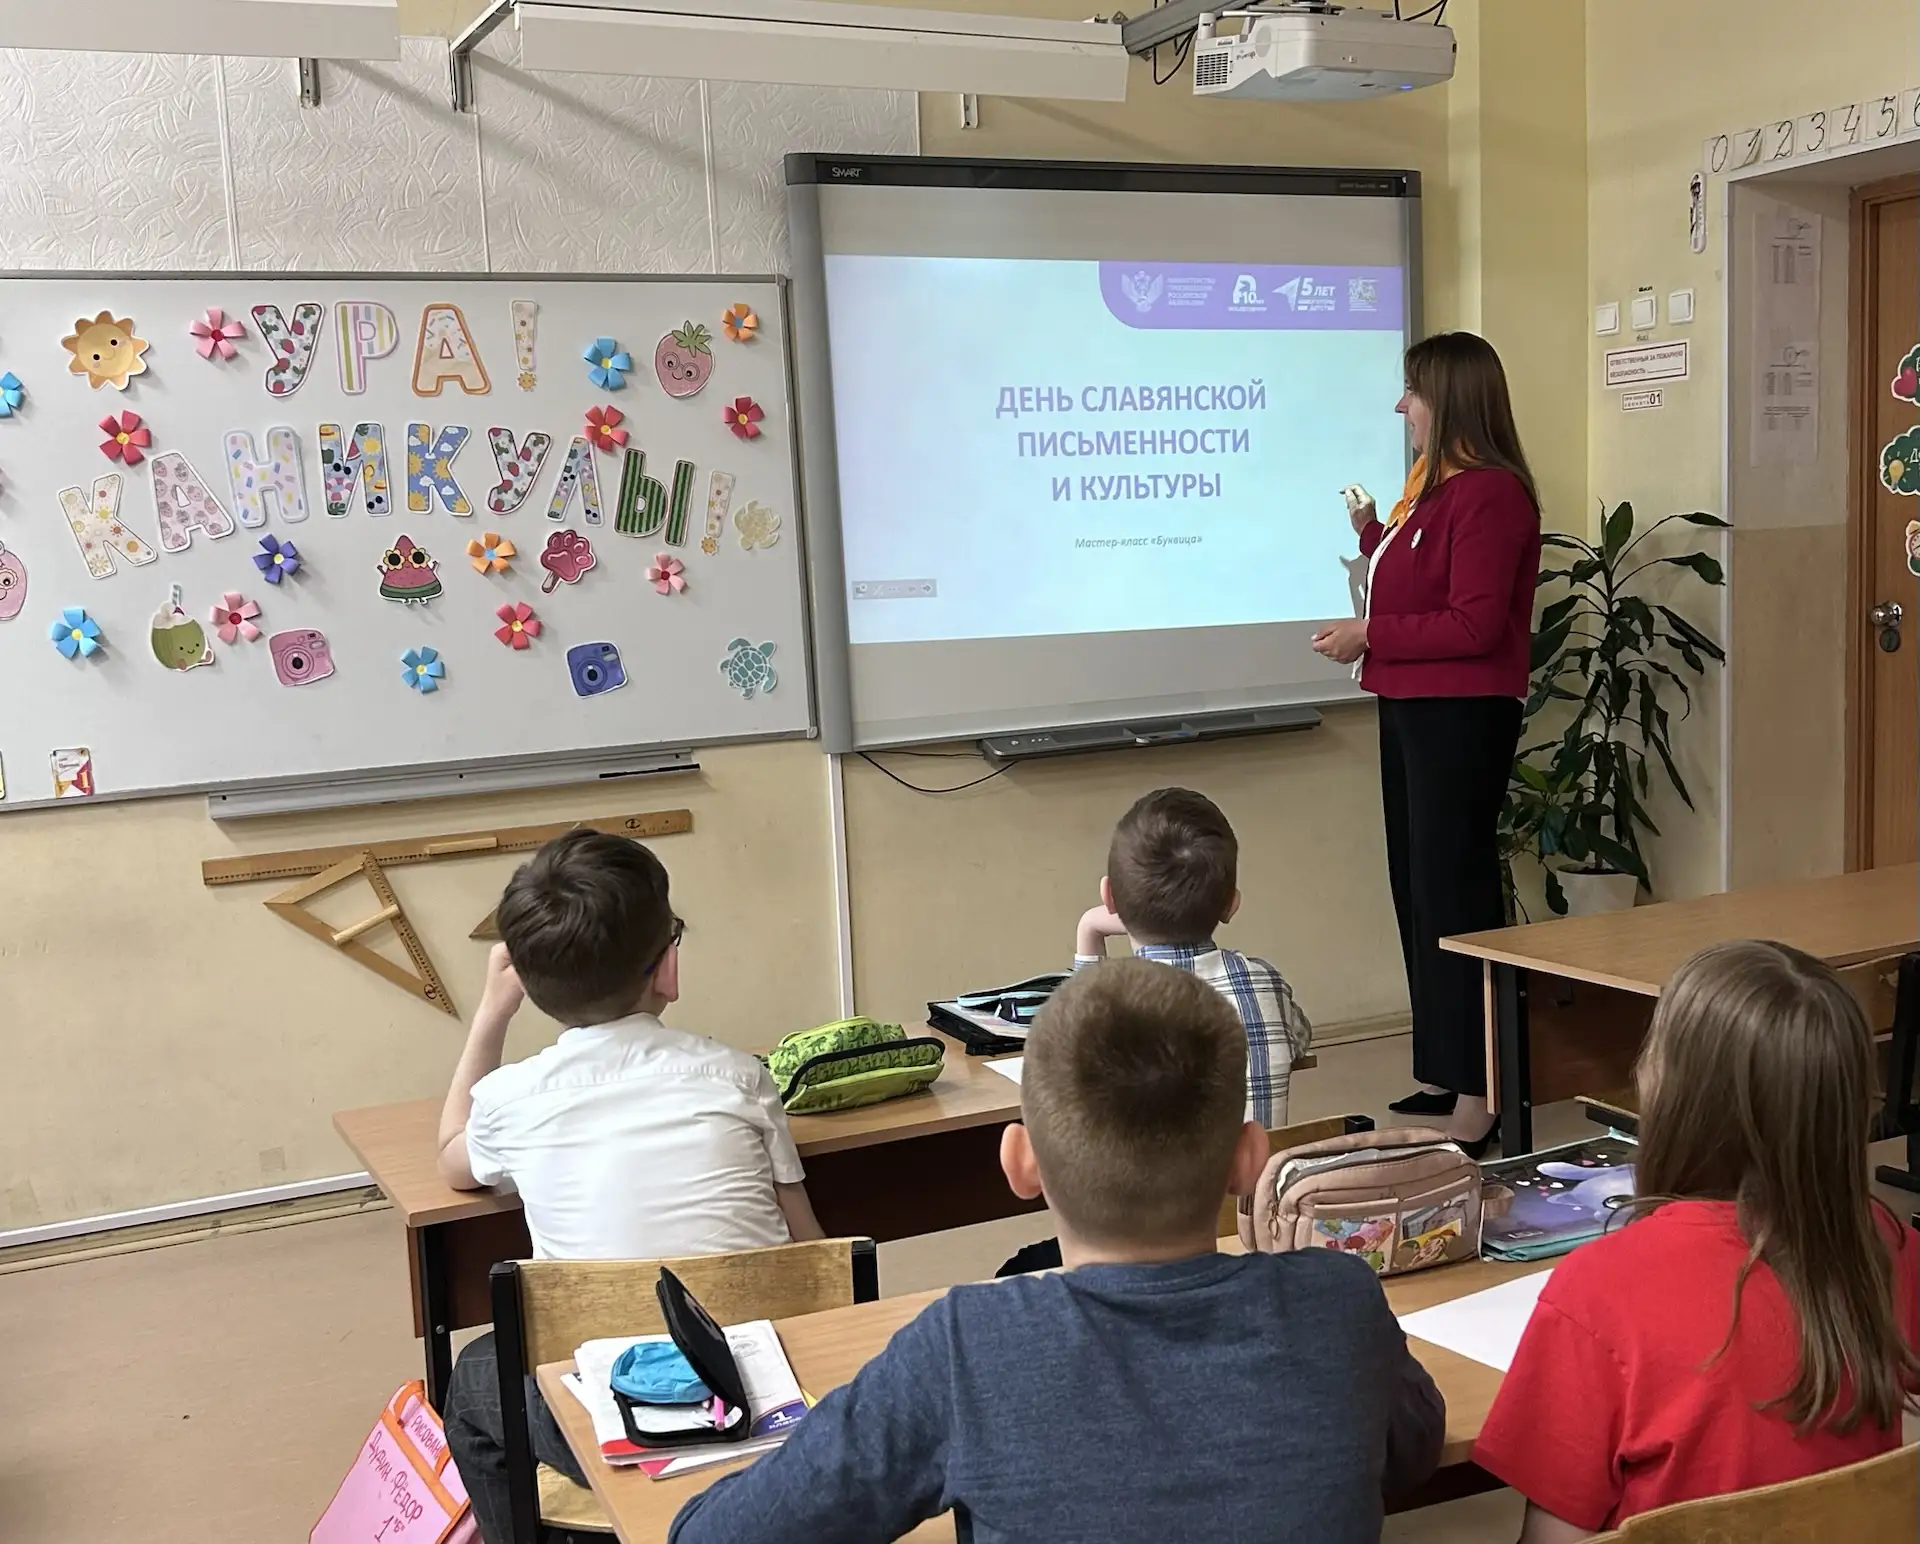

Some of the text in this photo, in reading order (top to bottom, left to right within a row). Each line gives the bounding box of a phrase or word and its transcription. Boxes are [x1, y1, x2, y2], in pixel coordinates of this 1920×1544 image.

[1711, 134, 1729, 173] 0
[1745, 128, 1762, 166] 1
[1773, 120, 1793, 160] 2
[1806, 111, 1826, 152] 3
[1843, 104, 1861, 144] 4
[1877, 95, 1896, 137] 5
[831, 166, 863, 178] SMART
[1301, 277, 1337, 296] 5 ЛЕТ
[251, 300, 540, 398] УРА!
[996, 378, 1267, 419] ДЕНЬ СЛАВЯНСКОЙ
[1649, 392, 1661, 405] 01
[1018, 428, 1250, 457] ПИСЬМЕННОСТИ
[58, 422, 736, 580] КАНИКУЛЫ!
[1051, 473, 1222, 501] И КУЛЬТУРЫ
[1075, 534, 1203, 549] Мастер-класс «Буквица»
[771, 1410, 793, 1424] 1
